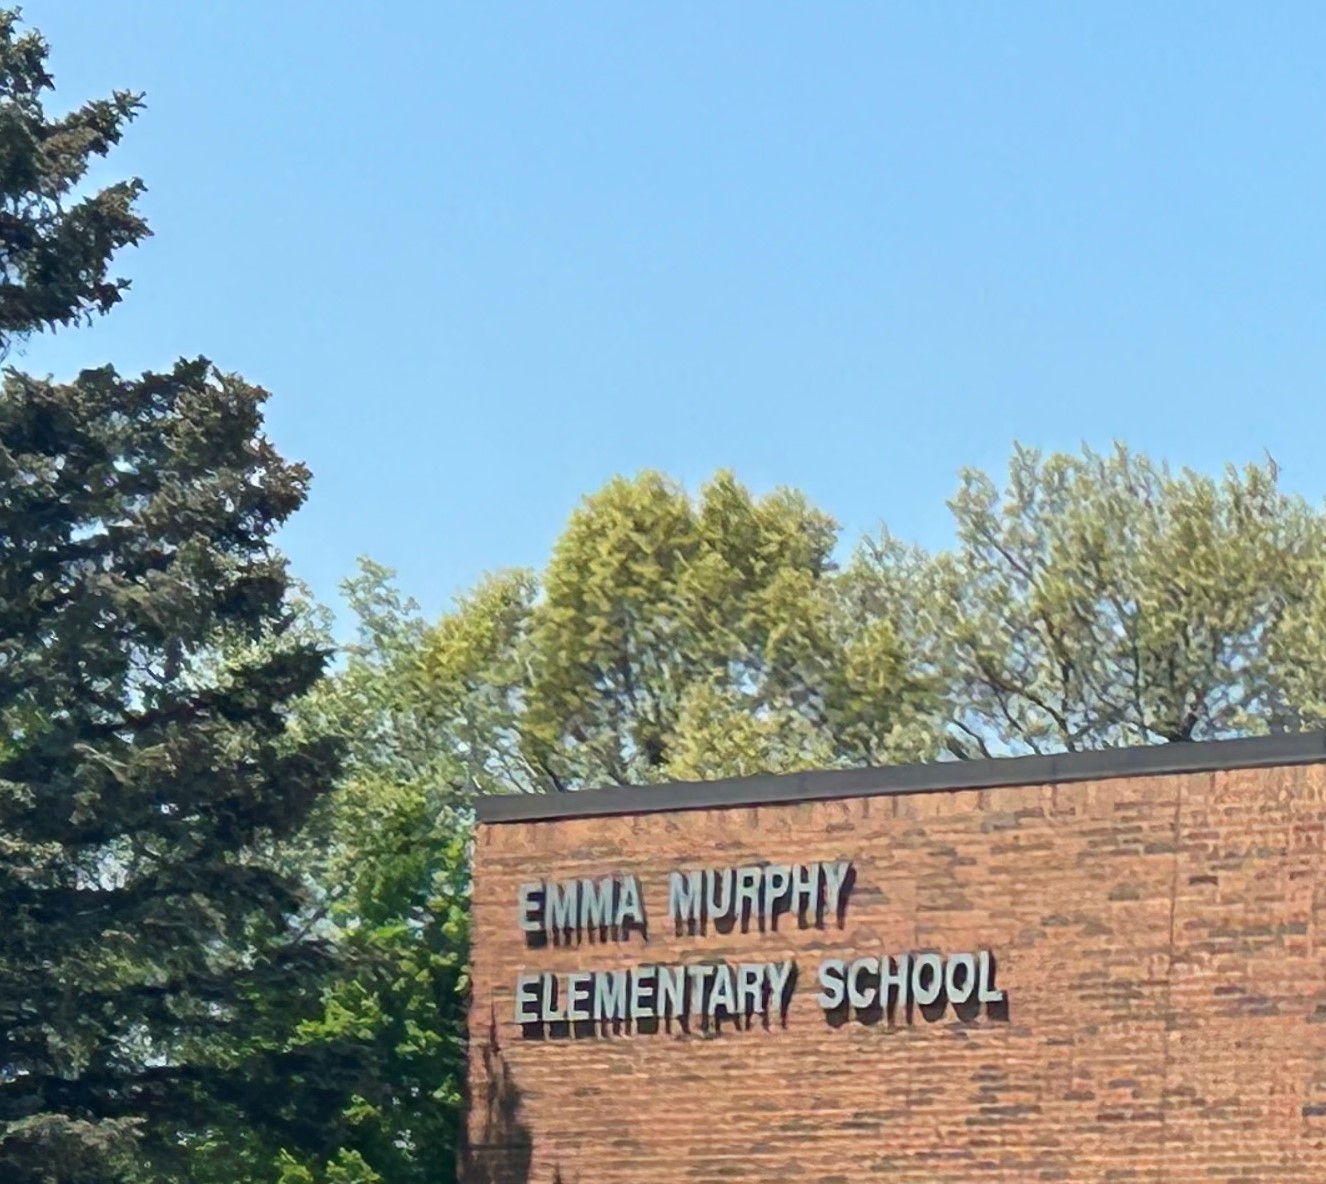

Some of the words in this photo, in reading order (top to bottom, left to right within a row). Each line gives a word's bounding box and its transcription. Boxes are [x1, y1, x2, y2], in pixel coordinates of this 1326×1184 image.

[517, 874, 645, 932] EMMA
[668, 862, 853, 922] MURPHY
[515, 961, 795, 1024] ELEMENTARY
[817, 950, 1004, 1010] SCHOOL
